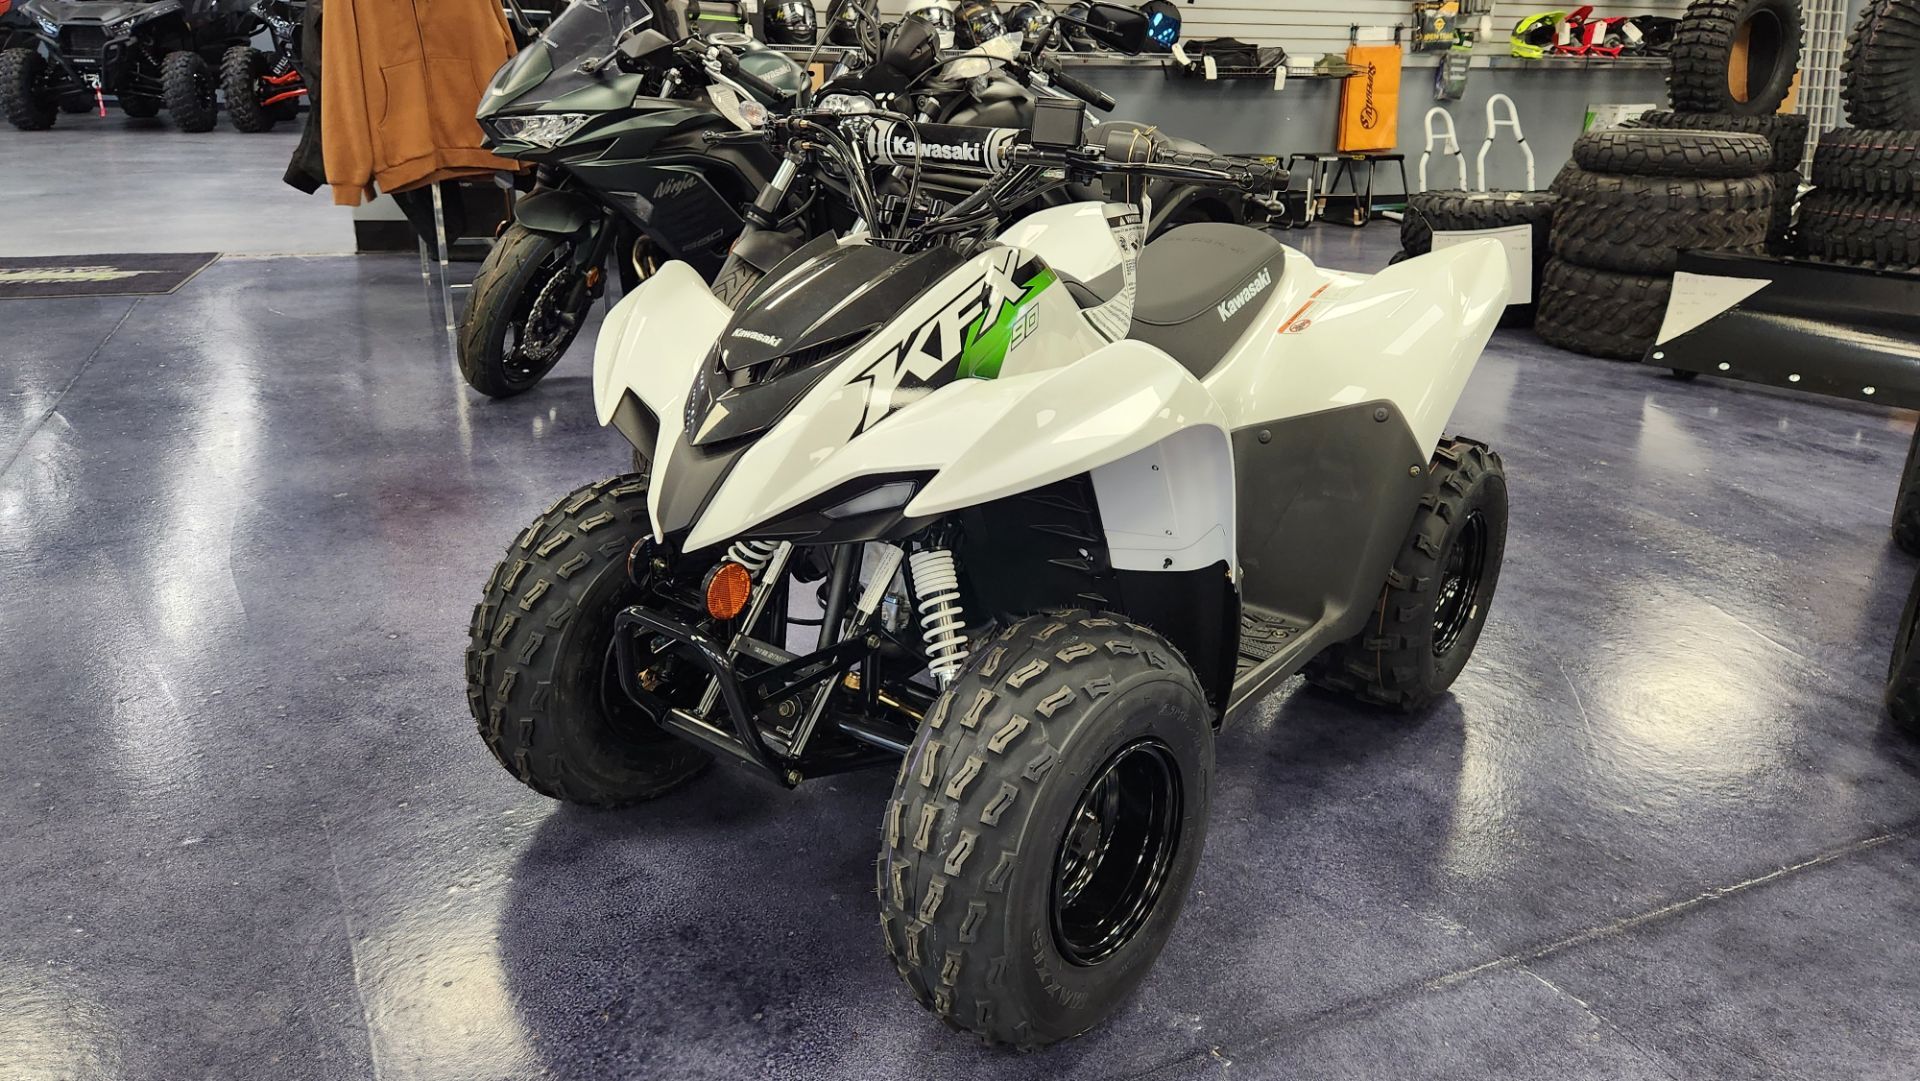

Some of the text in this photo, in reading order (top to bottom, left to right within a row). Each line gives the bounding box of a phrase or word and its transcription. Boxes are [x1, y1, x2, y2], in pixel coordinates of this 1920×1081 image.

[893, 136, 980, 162] Kawasaki
[653, 173, 698, 199] Ninja
[1217, 267, 1272, 323] Kawasaki
[731, 327, 783, 347] Kawasaki
[845, 248, 1036, 442] KFX
